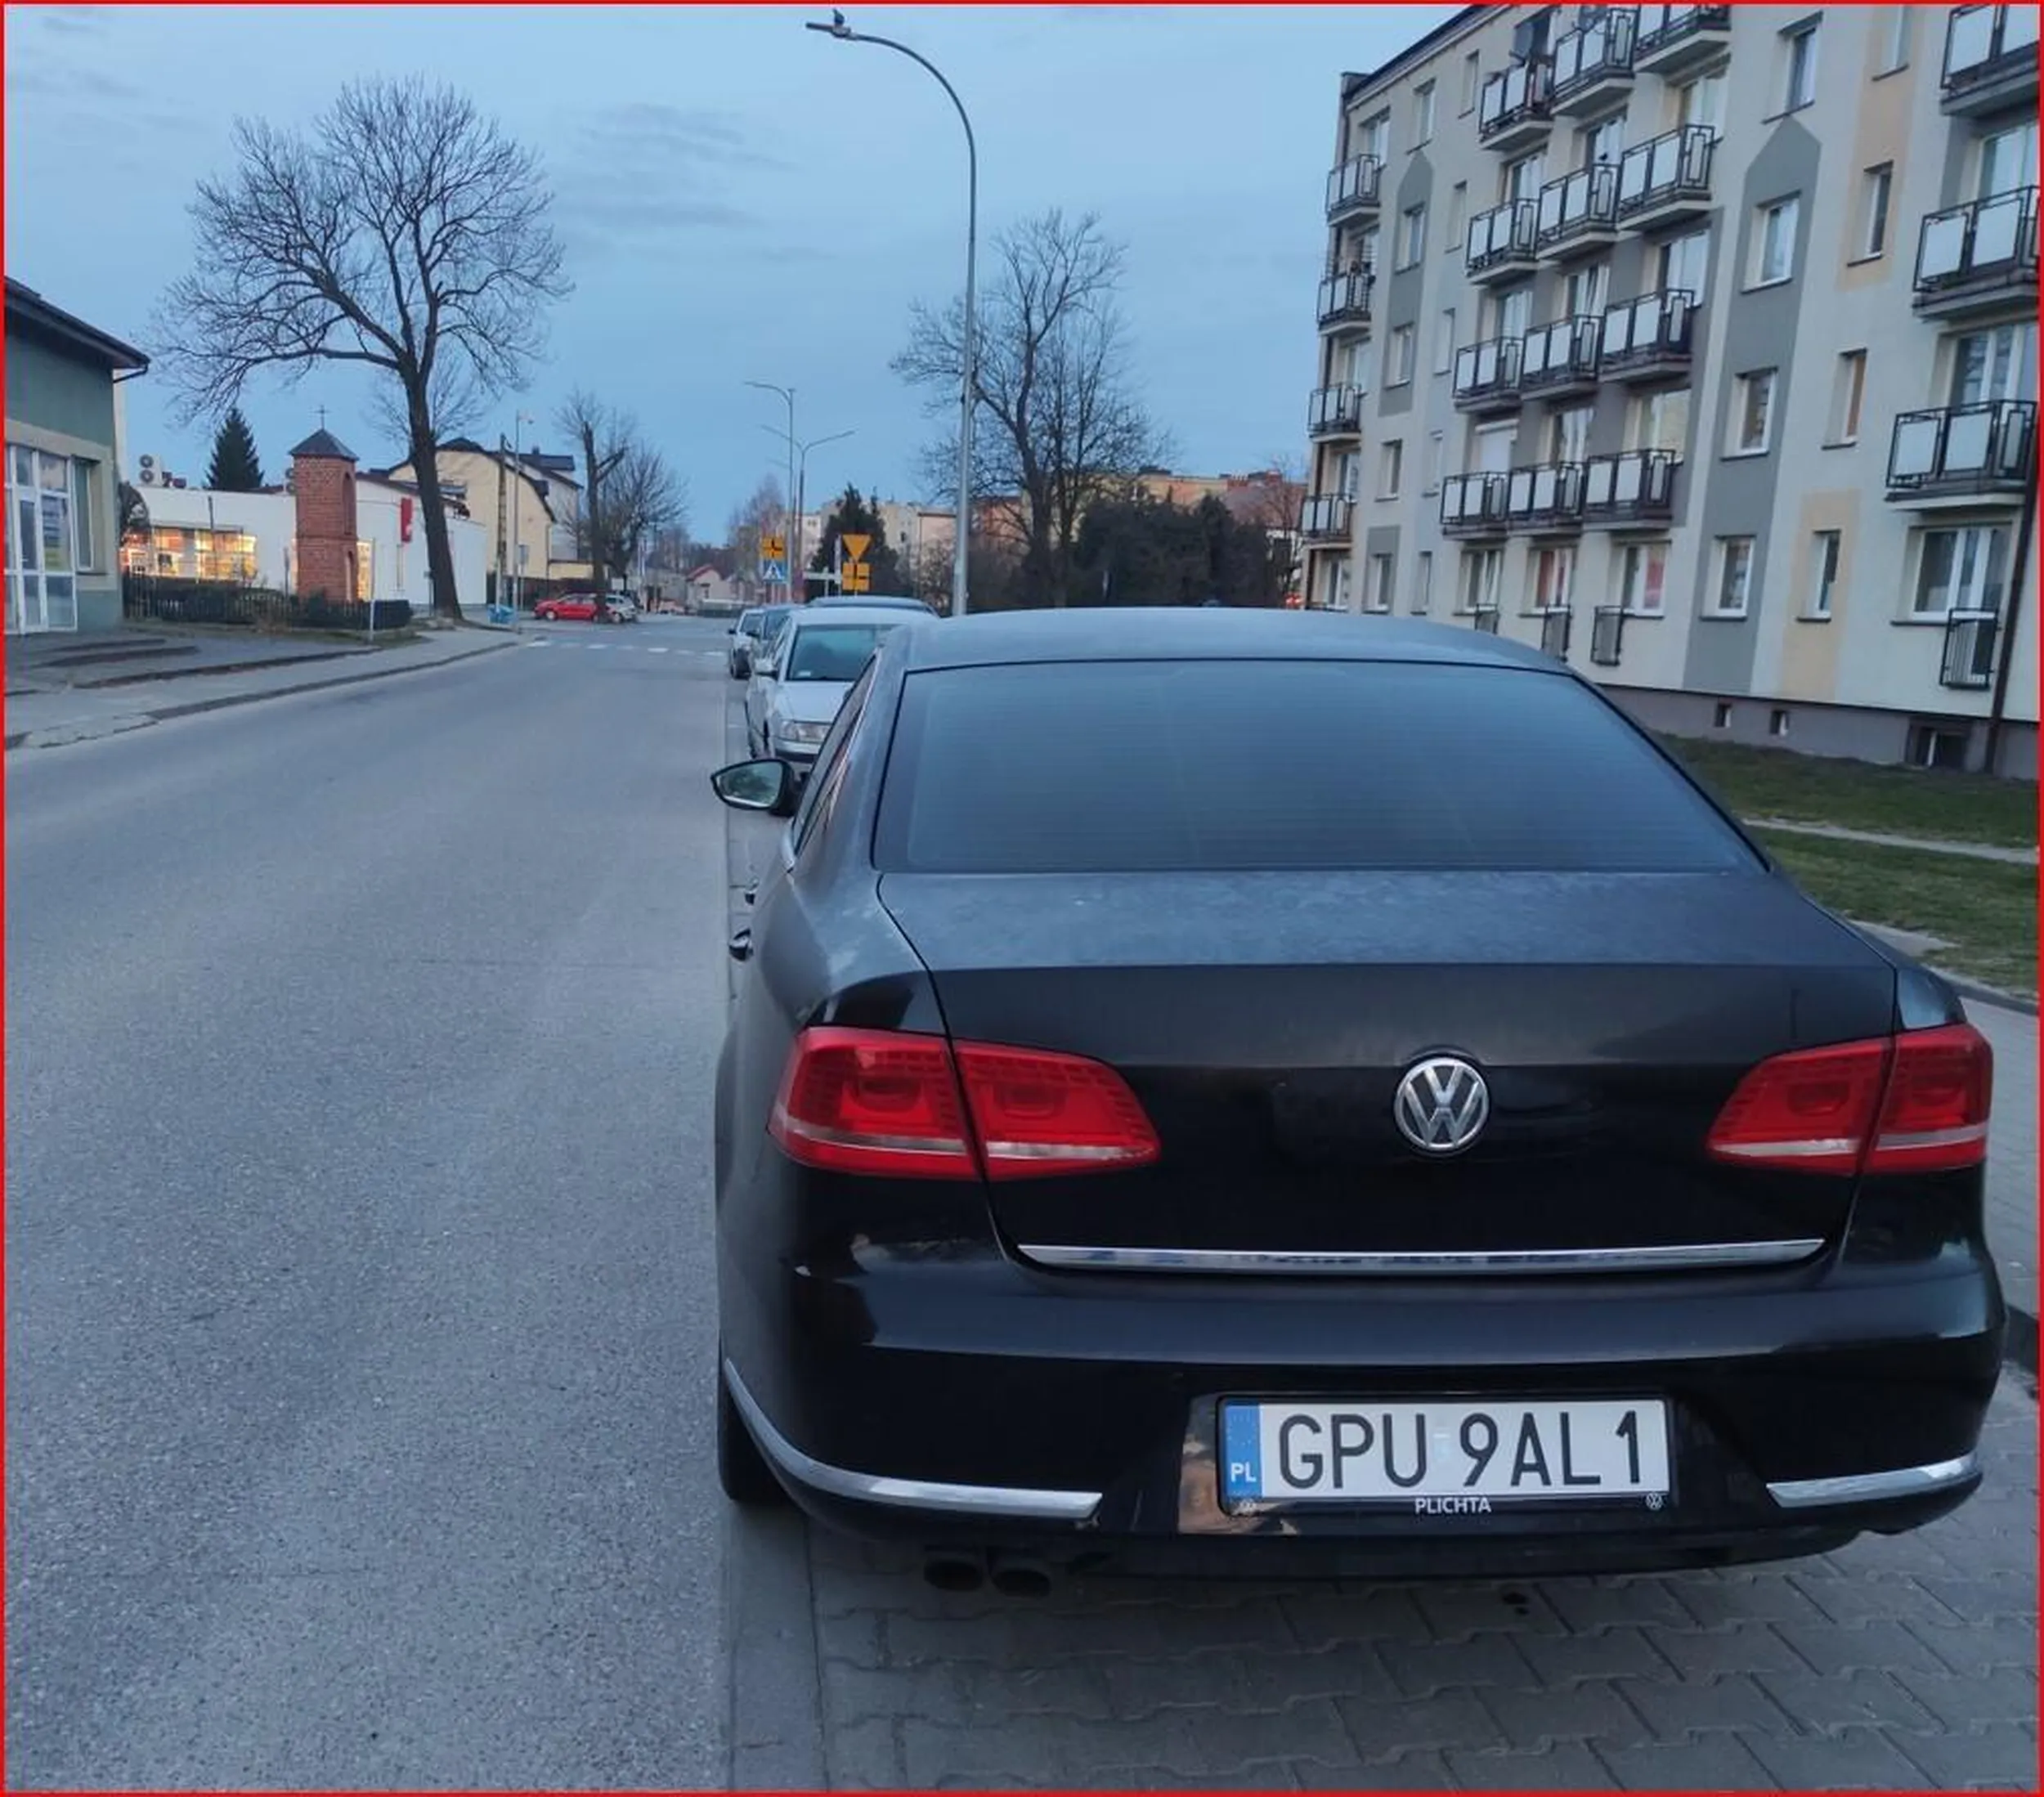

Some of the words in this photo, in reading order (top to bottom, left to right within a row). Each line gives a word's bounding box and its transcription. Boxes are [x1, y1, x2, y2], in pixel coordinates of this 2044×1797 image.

[1279, 1414, 1427, 1489] GPU
[1460, 1411, 1640, 1486] 9AL1
[1230, 1463, 1256, 1482] PL
[1414, 1497, 1492, 1514] PLICHTA
